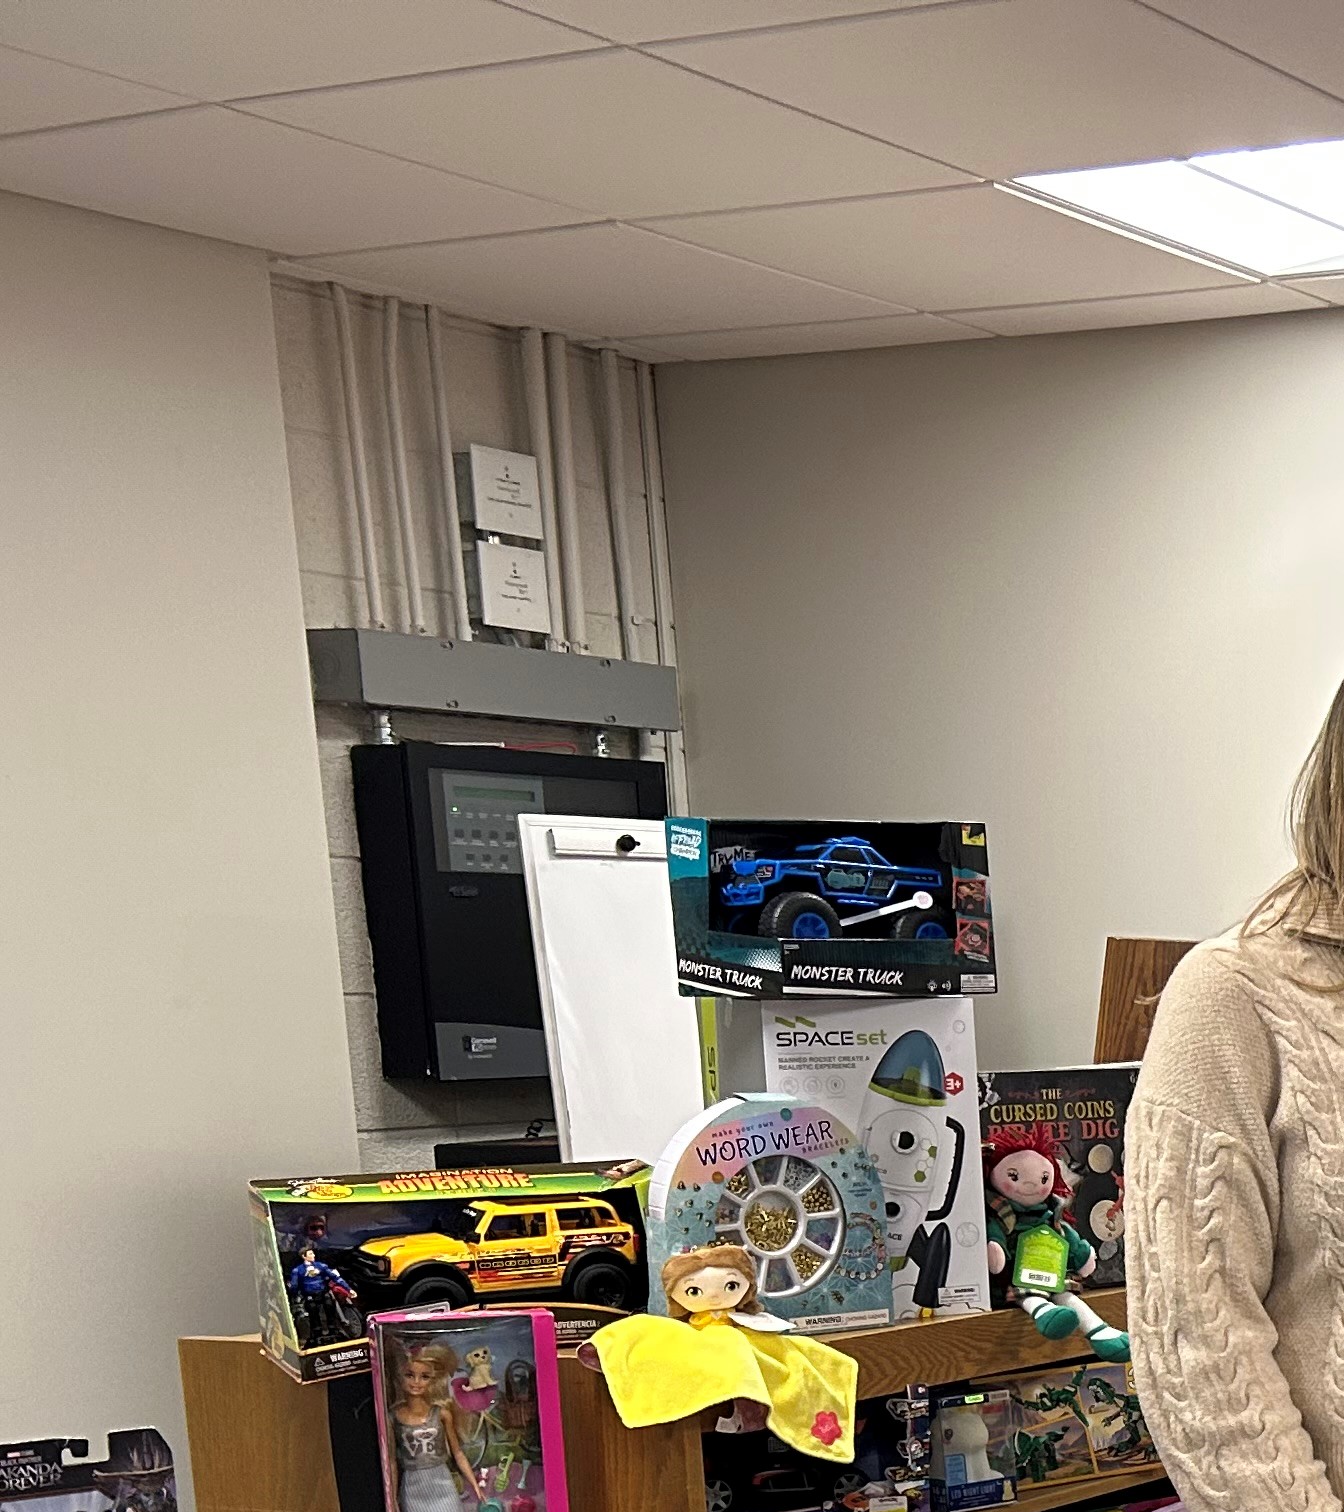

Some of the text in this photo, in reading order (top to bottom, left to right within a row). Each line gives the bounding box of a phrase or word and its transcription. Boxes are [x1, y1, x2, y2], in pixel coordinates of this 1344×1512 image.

[678, 957, 764, 991] MONSTER TRUCK
[790, 963, 904, 986] MONSTER TRUCK
[774, 1028, 888, 1049] SPACE set
[1041, 1088, 1063, 1101] THE
[990, 1100, 1116, 1124] CURSED COINS
[1081, 1119, 1120, 1140] DIG
[696, 1119, 833, 1167] WORD WEAR
[378, 1171, 535, 1195] ADVENTURE
[0, 1461, 63, 1479] AKANDA
